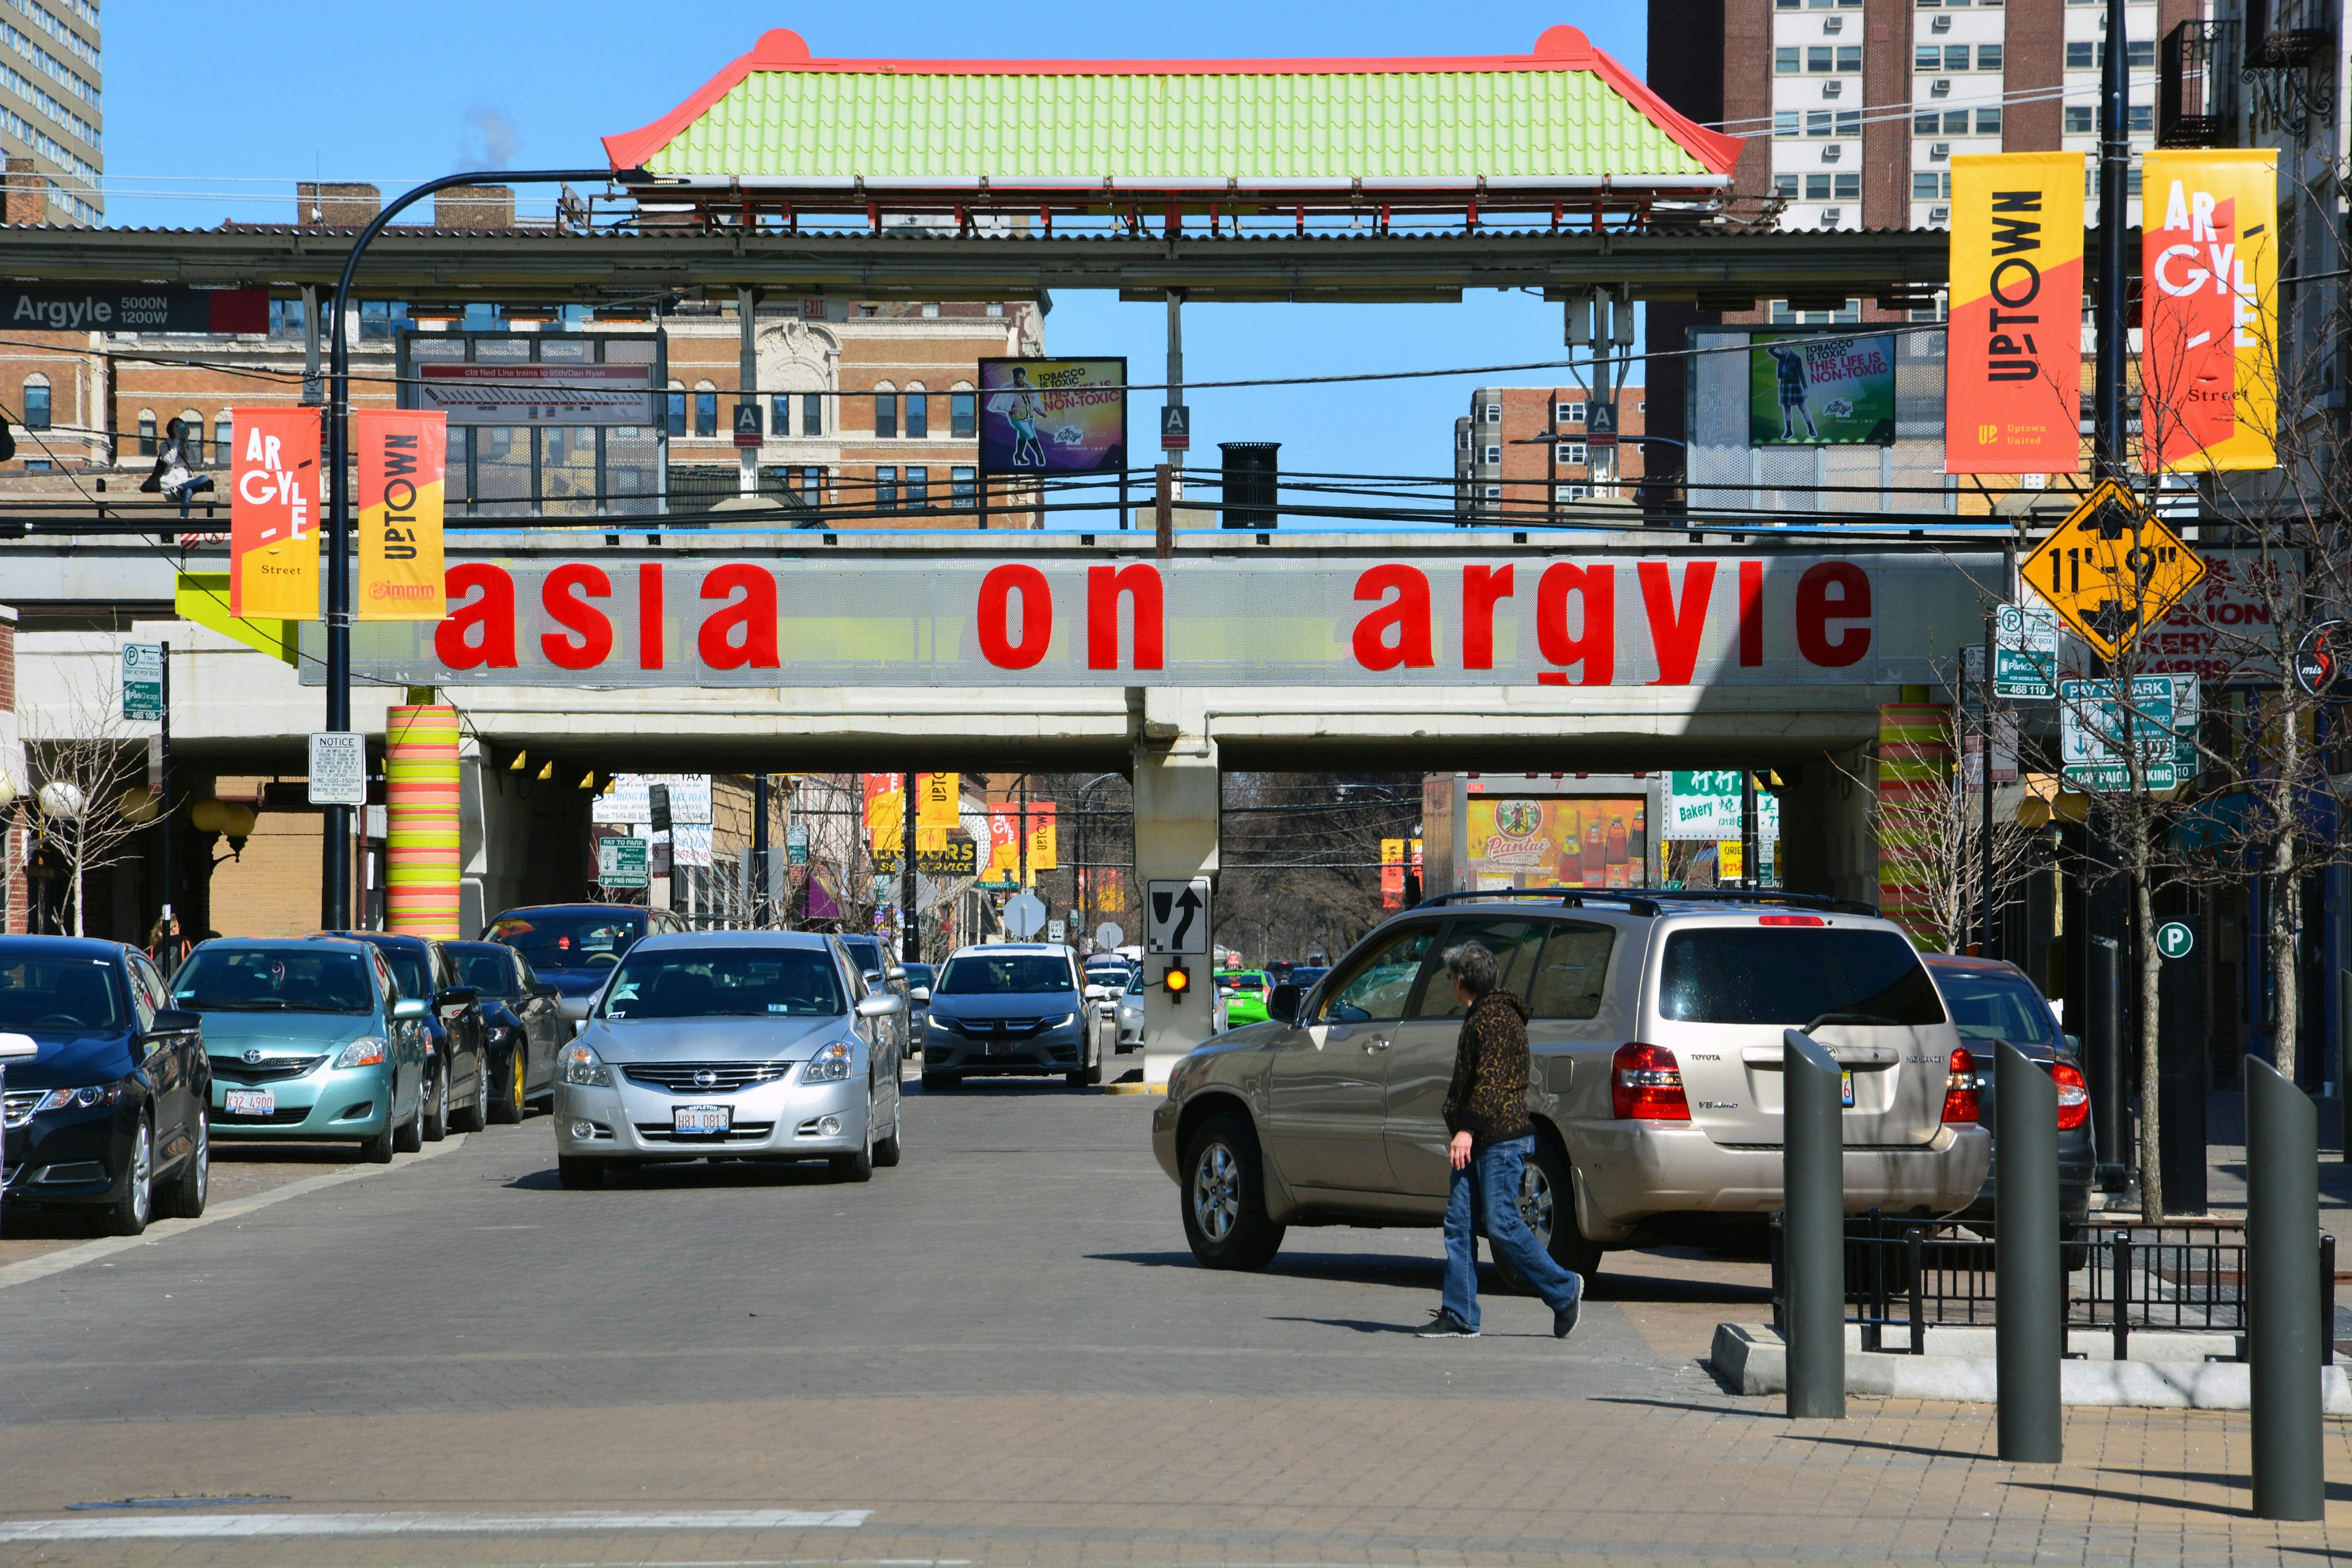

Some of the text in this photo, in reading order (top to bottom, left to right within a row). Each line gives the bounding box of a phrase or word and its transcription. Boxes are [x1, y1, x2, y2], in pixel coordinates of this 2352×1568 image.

[1988, 191, 2041, 382] UPTOWN
[121, 297, 167, 309] 5000N
[804, 300, 824, 314] EXIT
[13, 295, 112, 328] Argyle
[121, 311, 168, 324] 1200W
[1804, 340, 1854, 354] TOBACCO
[1806, 349, 1847, 362] IS TOXIC
[1808, 352, 1881, 372] THIS LIFE IS
[1038, 368, 1085, 382] TOBACCO
[1811, 362, 1888, 384] NON-TOXIC
[1050, 377, 1079, 387] TOXIC
[1044, 391, 1120, 412] NON-TOXIC
[2188, 388, 2248, 402] Street
[739, 408, 756, 426] A
[1167, 409, 1183, 428] A
[1594, 407, 1610, 426] A
[2007, 424, 2046, 434] Uptown
[2007, 435, 2041, 445] United
[384, 435, 418, 559] UPTOWN
[261, 565, 301, 575] Street
[387, 580, 434, 596] immm
[977, 564, 1164, 669] on
[1352, 561, 1872, 685] argyle
[2010, 685, 2027, 694] 468
[2030, 685, 2046, 695] 110
[2070, 685, 2097, 697] PAY
[1679, 802, 1713, 821] Bakery
[1719, 818, 1735, 827] (312)
[1489, 837, 1546, 856] Pantai
[1457, 867, 1463, 875] 7
[1654, 867, 1660, 875] 7
[2168, 929, 2184, 951] P
[1844, 1080, 1850, 1098] 6
[227, 1096, 273, 1109] X32 4900
[679, 1115, 727, 1128] H81 0813
